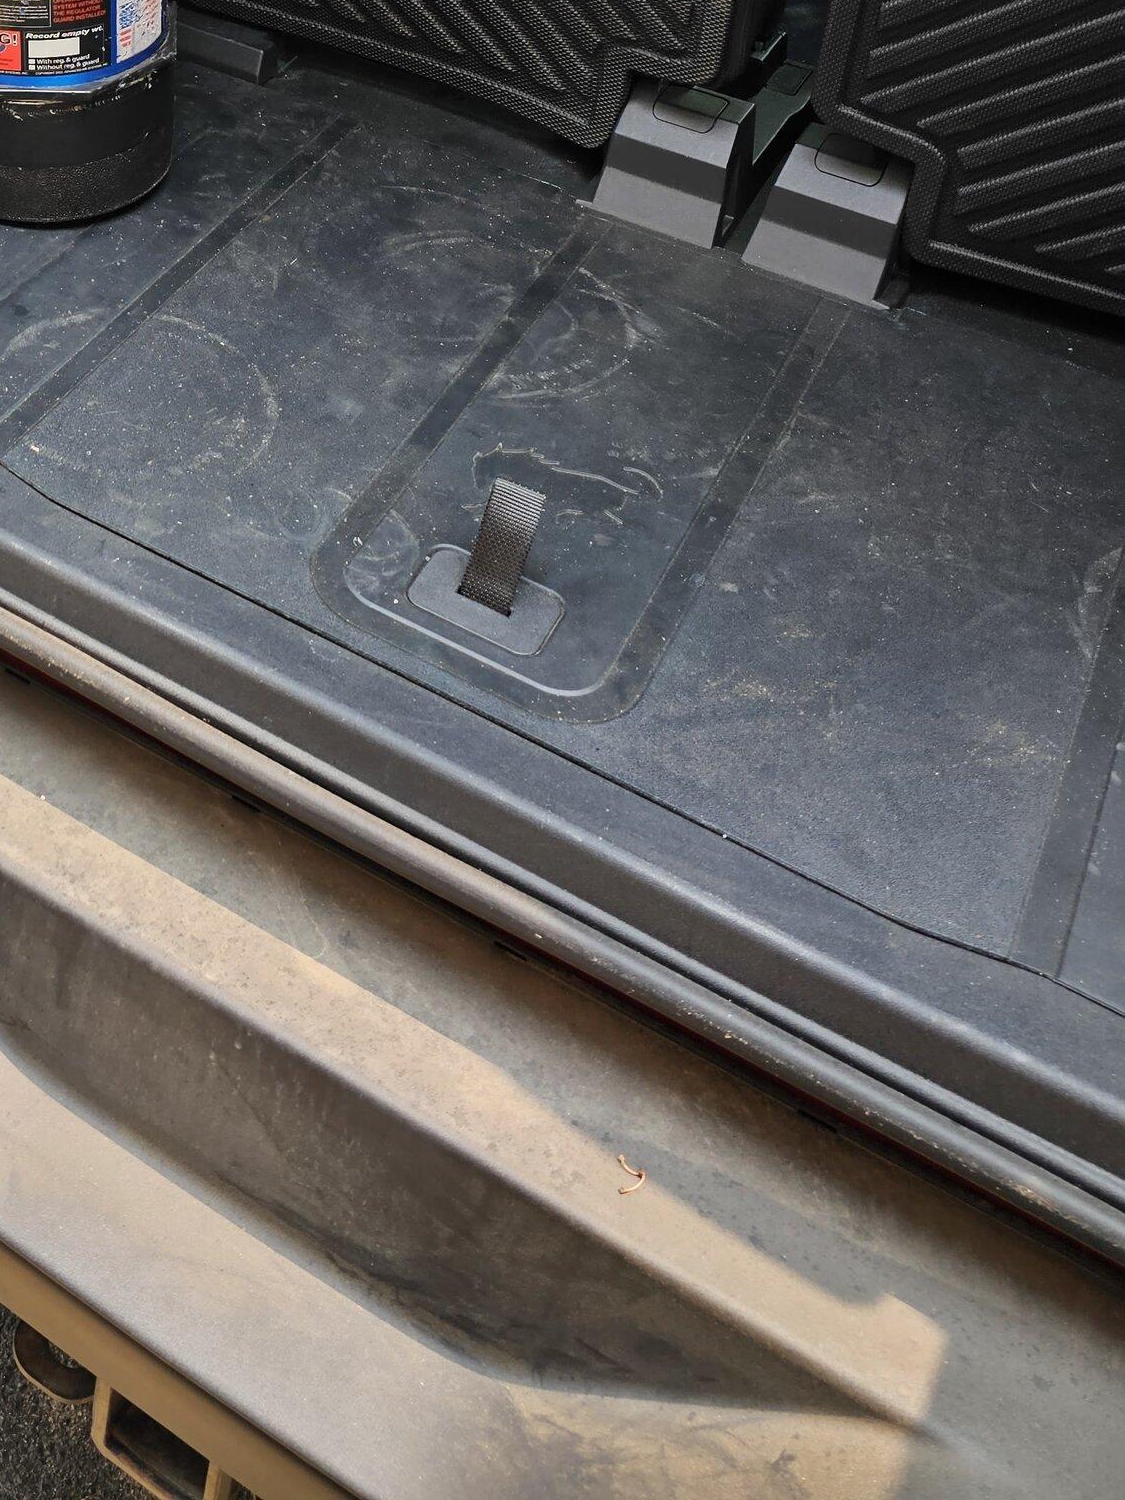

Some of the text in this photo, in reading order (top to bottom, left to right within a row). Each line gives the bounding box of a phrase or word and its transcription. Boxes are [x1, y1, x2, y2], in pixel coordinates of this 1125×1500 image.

[61, 28, 90, 38] empty
[72, 53, 90, 63] guard
[36, 63, 63, 71] Without
[82, 57, 100, 67] guard
